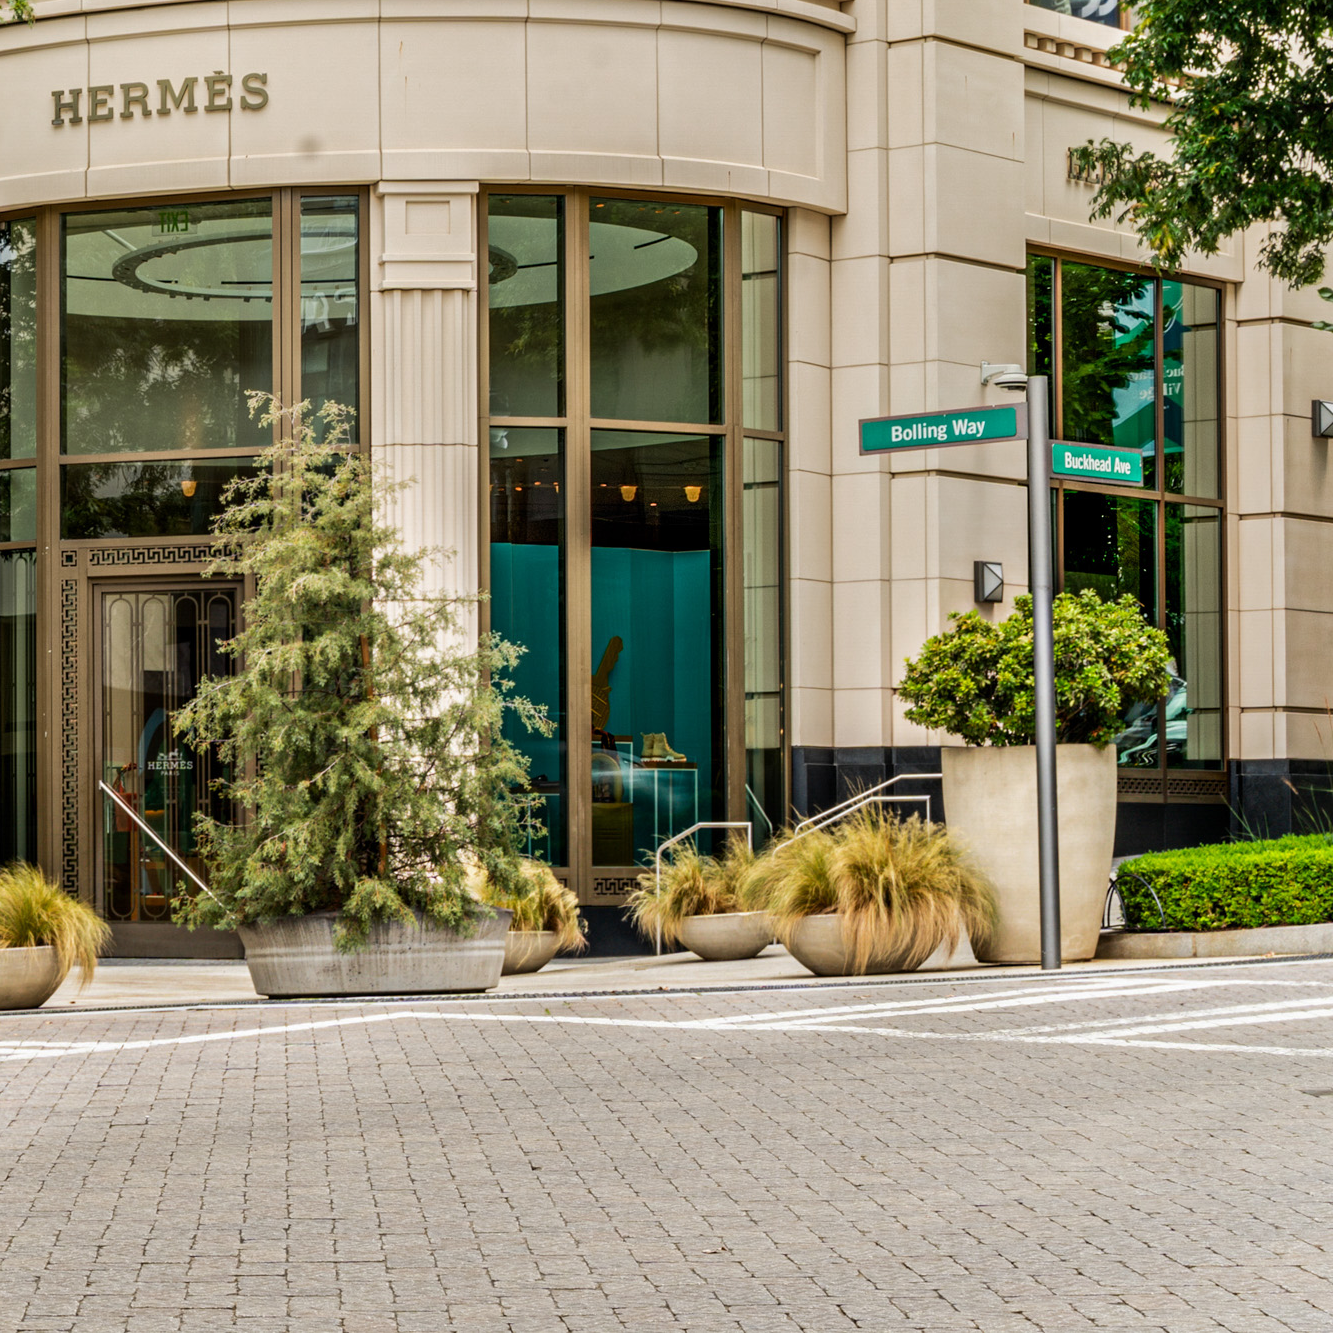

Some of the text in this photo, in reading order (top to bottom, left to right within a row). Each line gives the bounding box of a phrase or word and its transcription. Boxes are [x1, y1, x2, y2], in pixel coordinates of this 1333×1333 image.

[51, 70, 269, 126] HERMÈS
[890, 418, 986, 443] Bolling Way
[1064, 451, 1131, 475] Buckhead Ave
